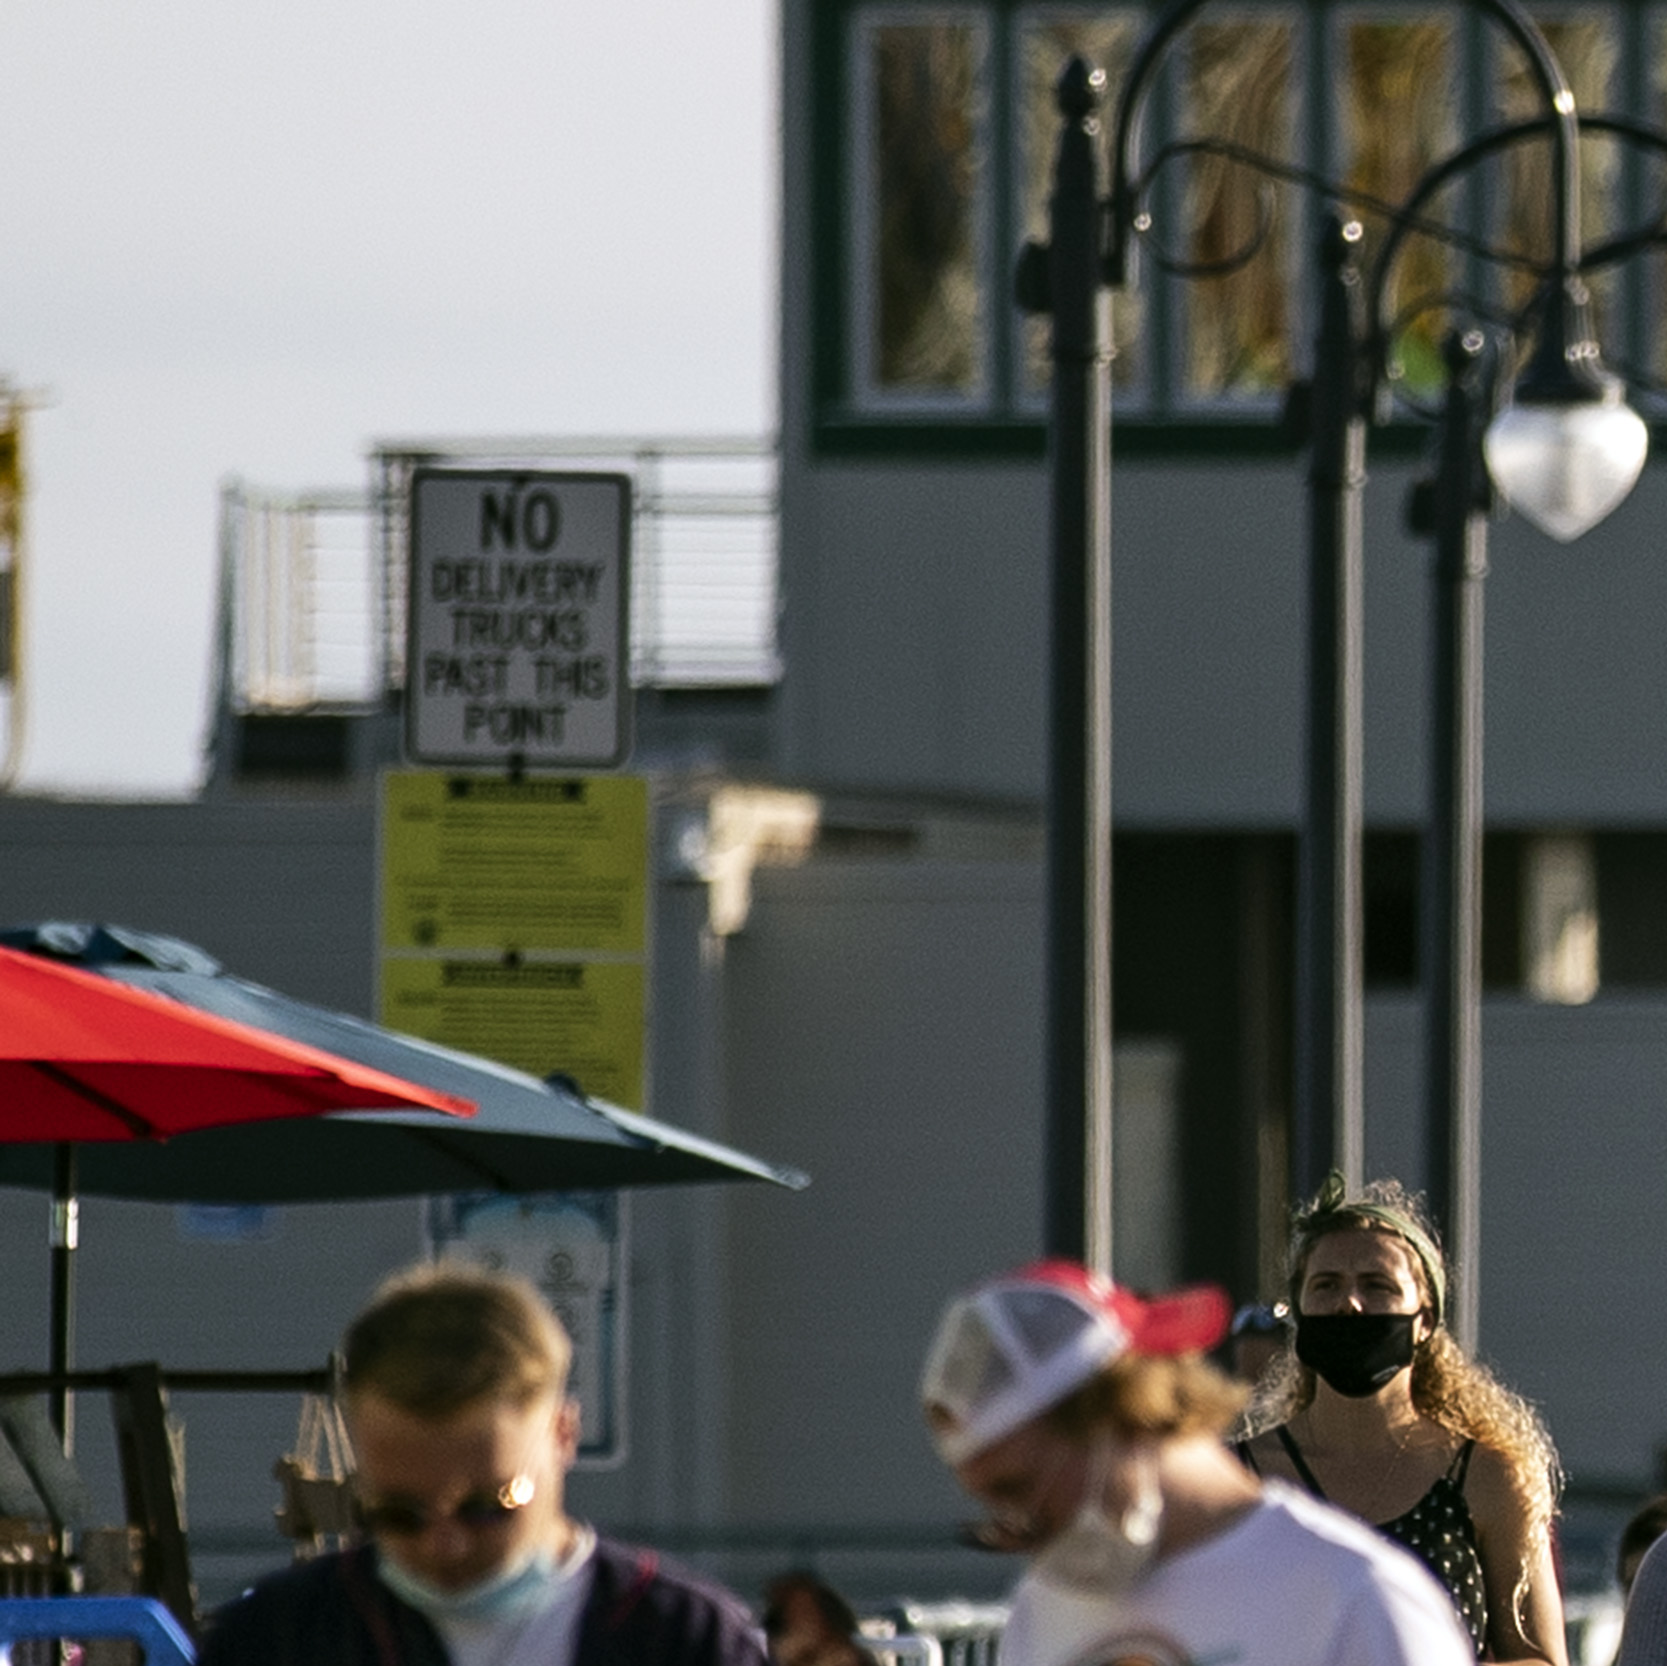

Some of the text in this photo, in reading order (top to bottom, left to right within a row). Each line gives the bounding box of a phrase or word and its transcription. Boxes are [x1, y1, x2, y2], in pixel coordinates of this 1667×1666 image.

[480, 489, 560, 553] NO
[431, 557, 605, 601] DELIVERY
[451, 608, 588, 650] TRUCKS
[424, 655, 608, 700] PAST THIS
[463, 705, 567, 747] POINT
